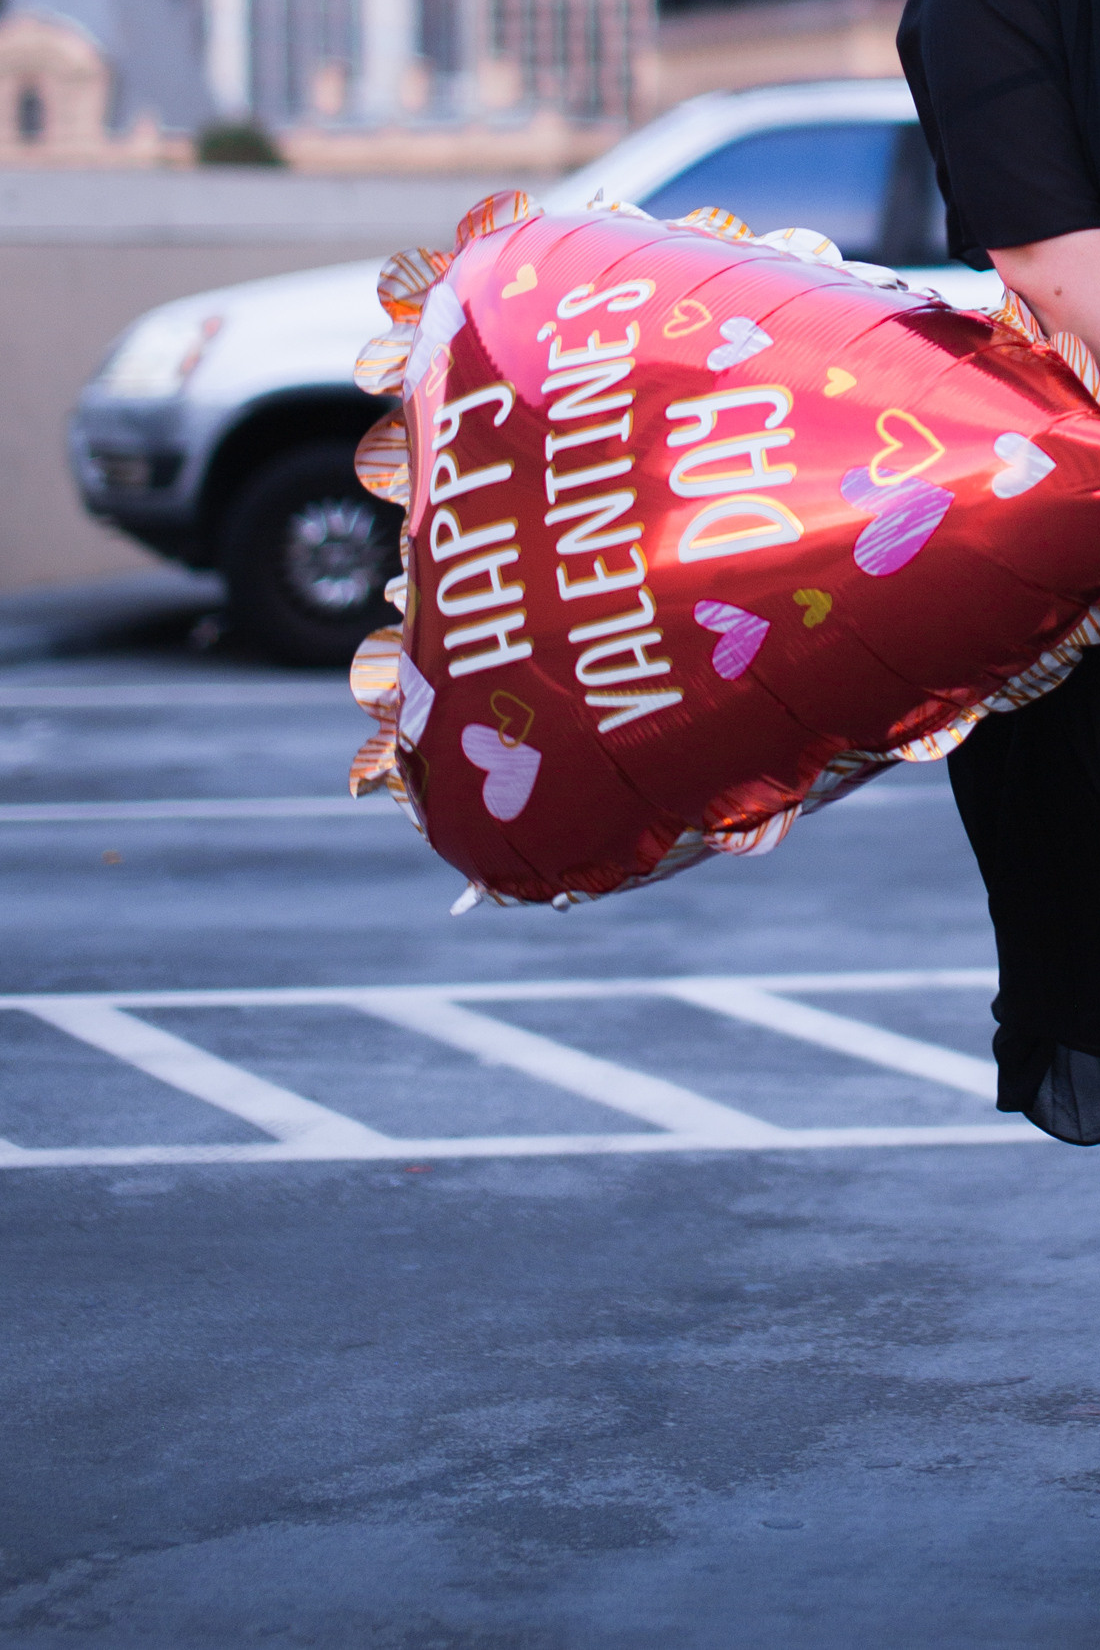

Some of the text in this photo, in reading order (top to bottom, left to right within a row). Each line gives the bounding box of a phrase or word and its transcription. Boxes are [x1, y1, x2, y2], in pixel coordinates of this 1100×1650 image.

[429, 379, 533, 680] HAPPY
[537, 277, 684, 734] VALENTINE'S
[665, 383, 805, 564] DAY
